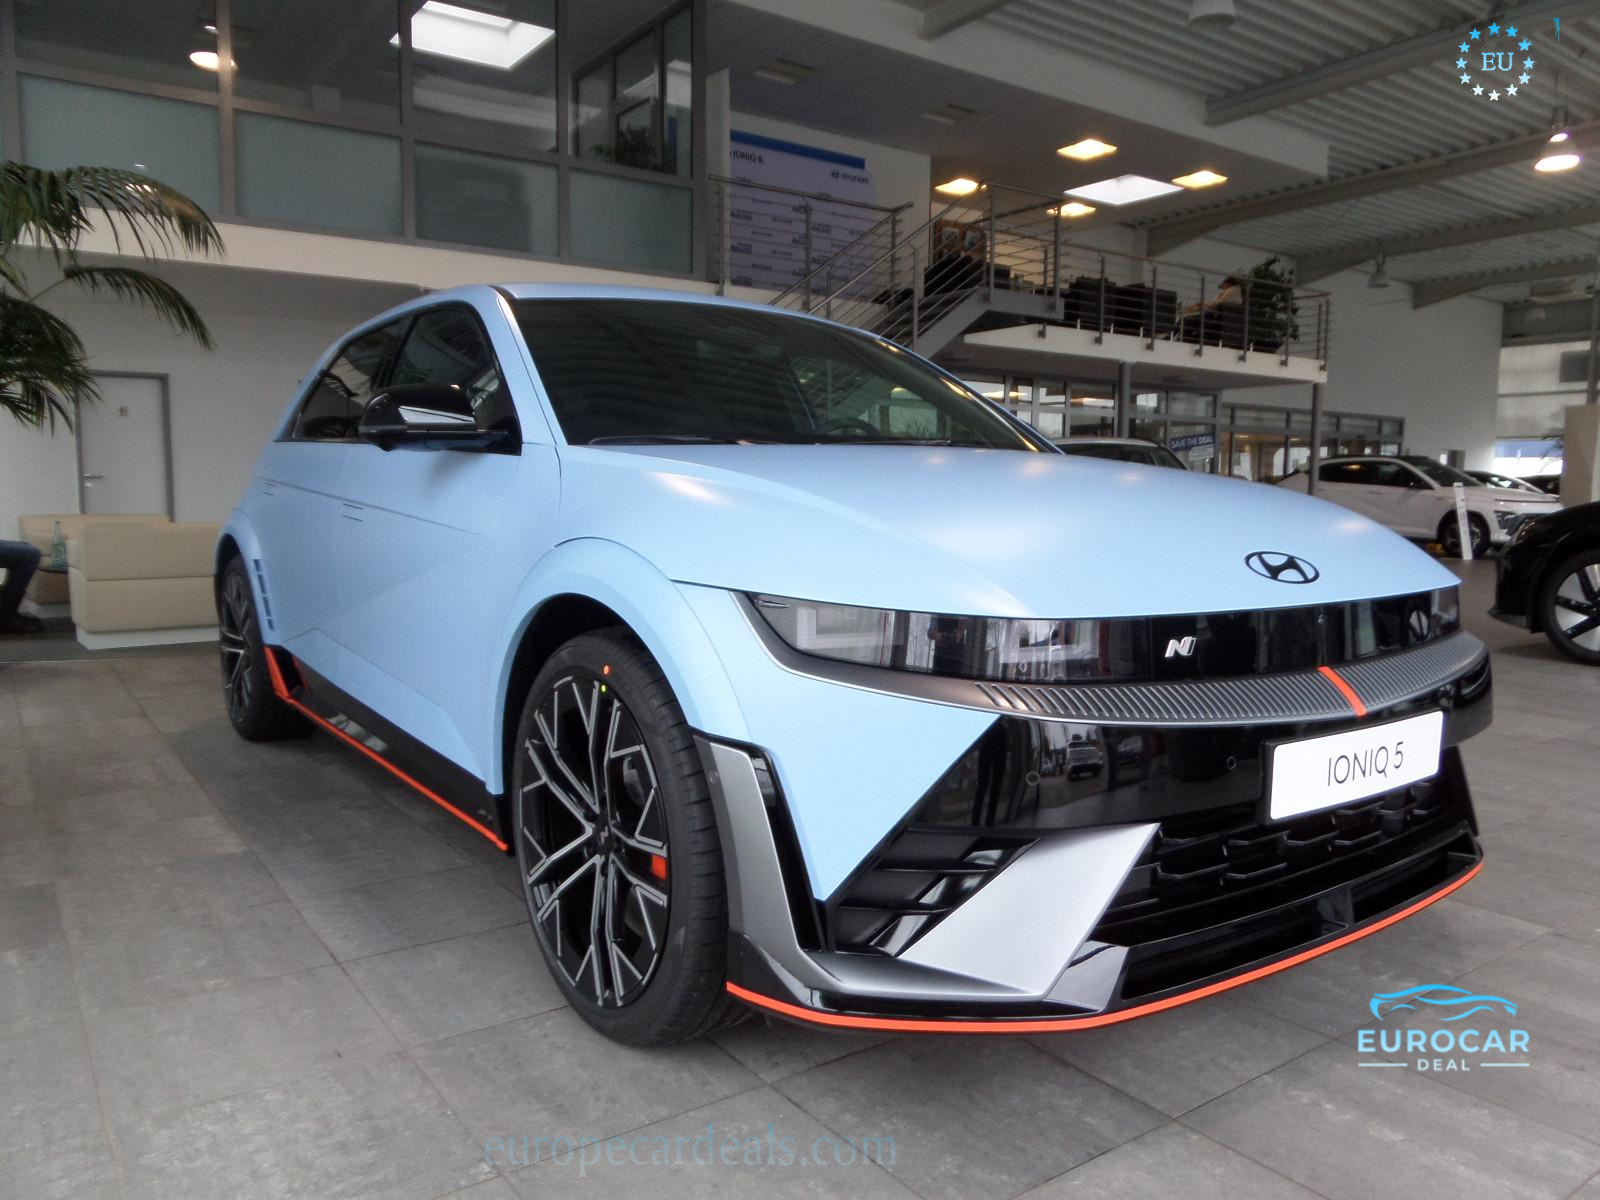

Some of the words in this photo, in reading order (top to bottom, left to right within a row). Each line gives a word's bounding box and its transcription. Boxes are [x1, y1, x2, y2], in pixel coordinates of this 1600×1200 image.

[1198, 435, 1214, 445] DEAL
[1164, 635, 1196, 657] N
[1327, 746, 1389, 787] IONIQ
[1393, 741, 1404, 769] 5
